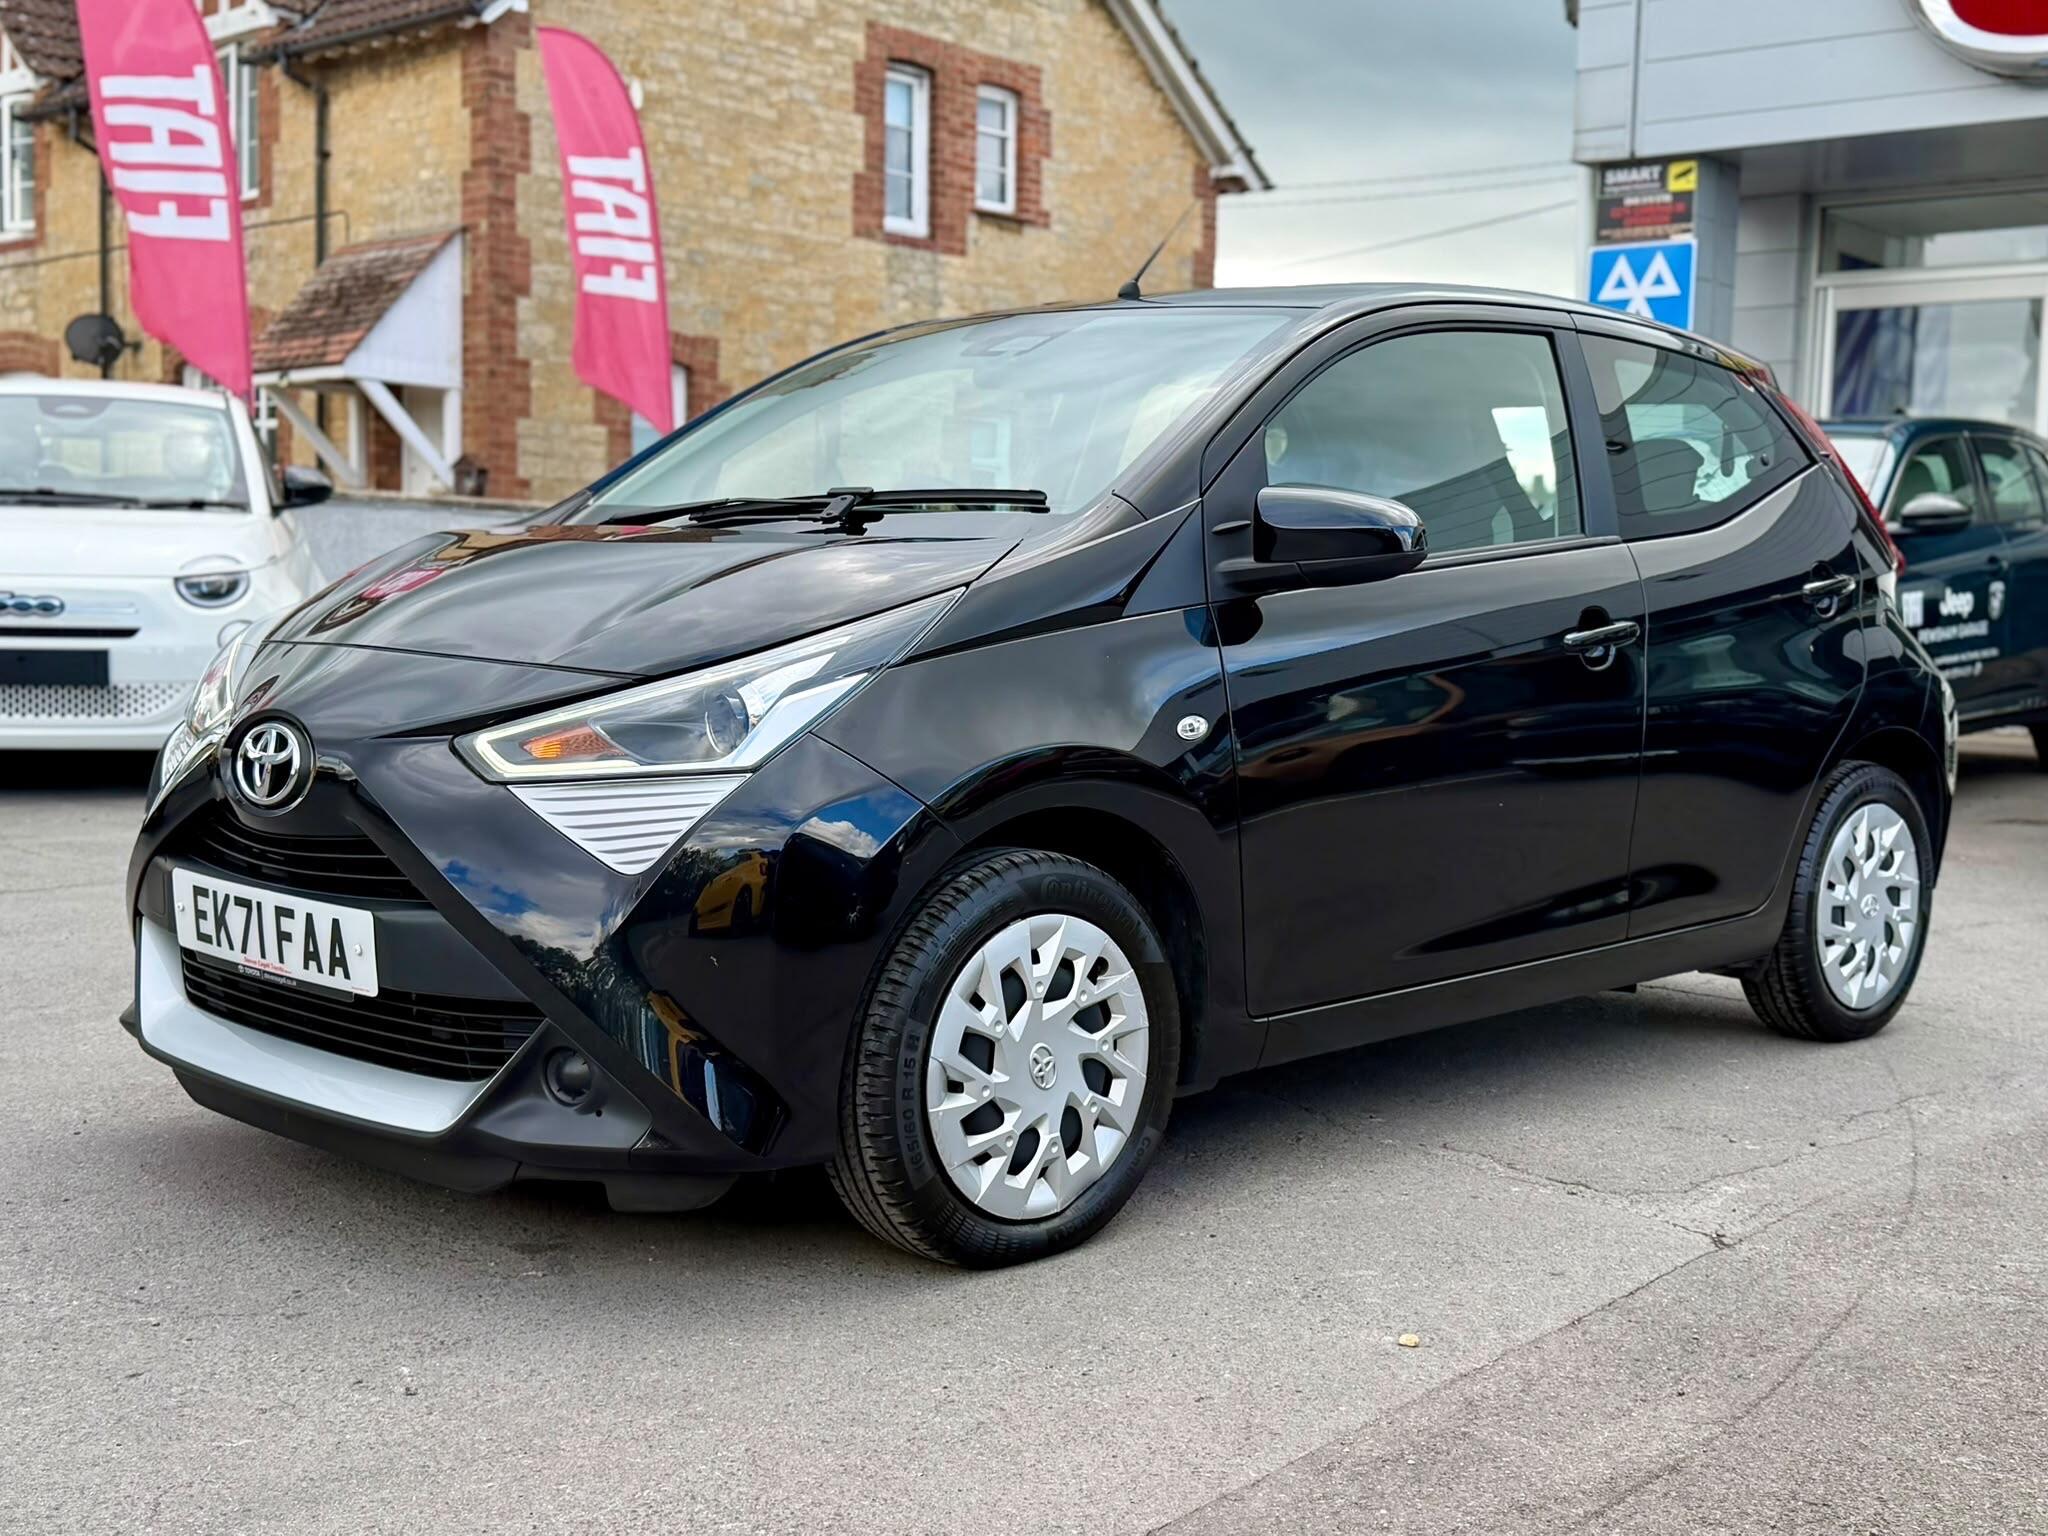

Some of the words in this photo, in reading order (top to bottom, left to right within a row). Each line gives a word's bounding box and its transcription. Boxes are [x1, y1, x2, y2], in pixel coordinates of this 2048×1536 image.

[1939, 586, 1974, 619] Jeep
[192, 885, 267, 960] EK71
[274, 905, 352, 981] FAA
